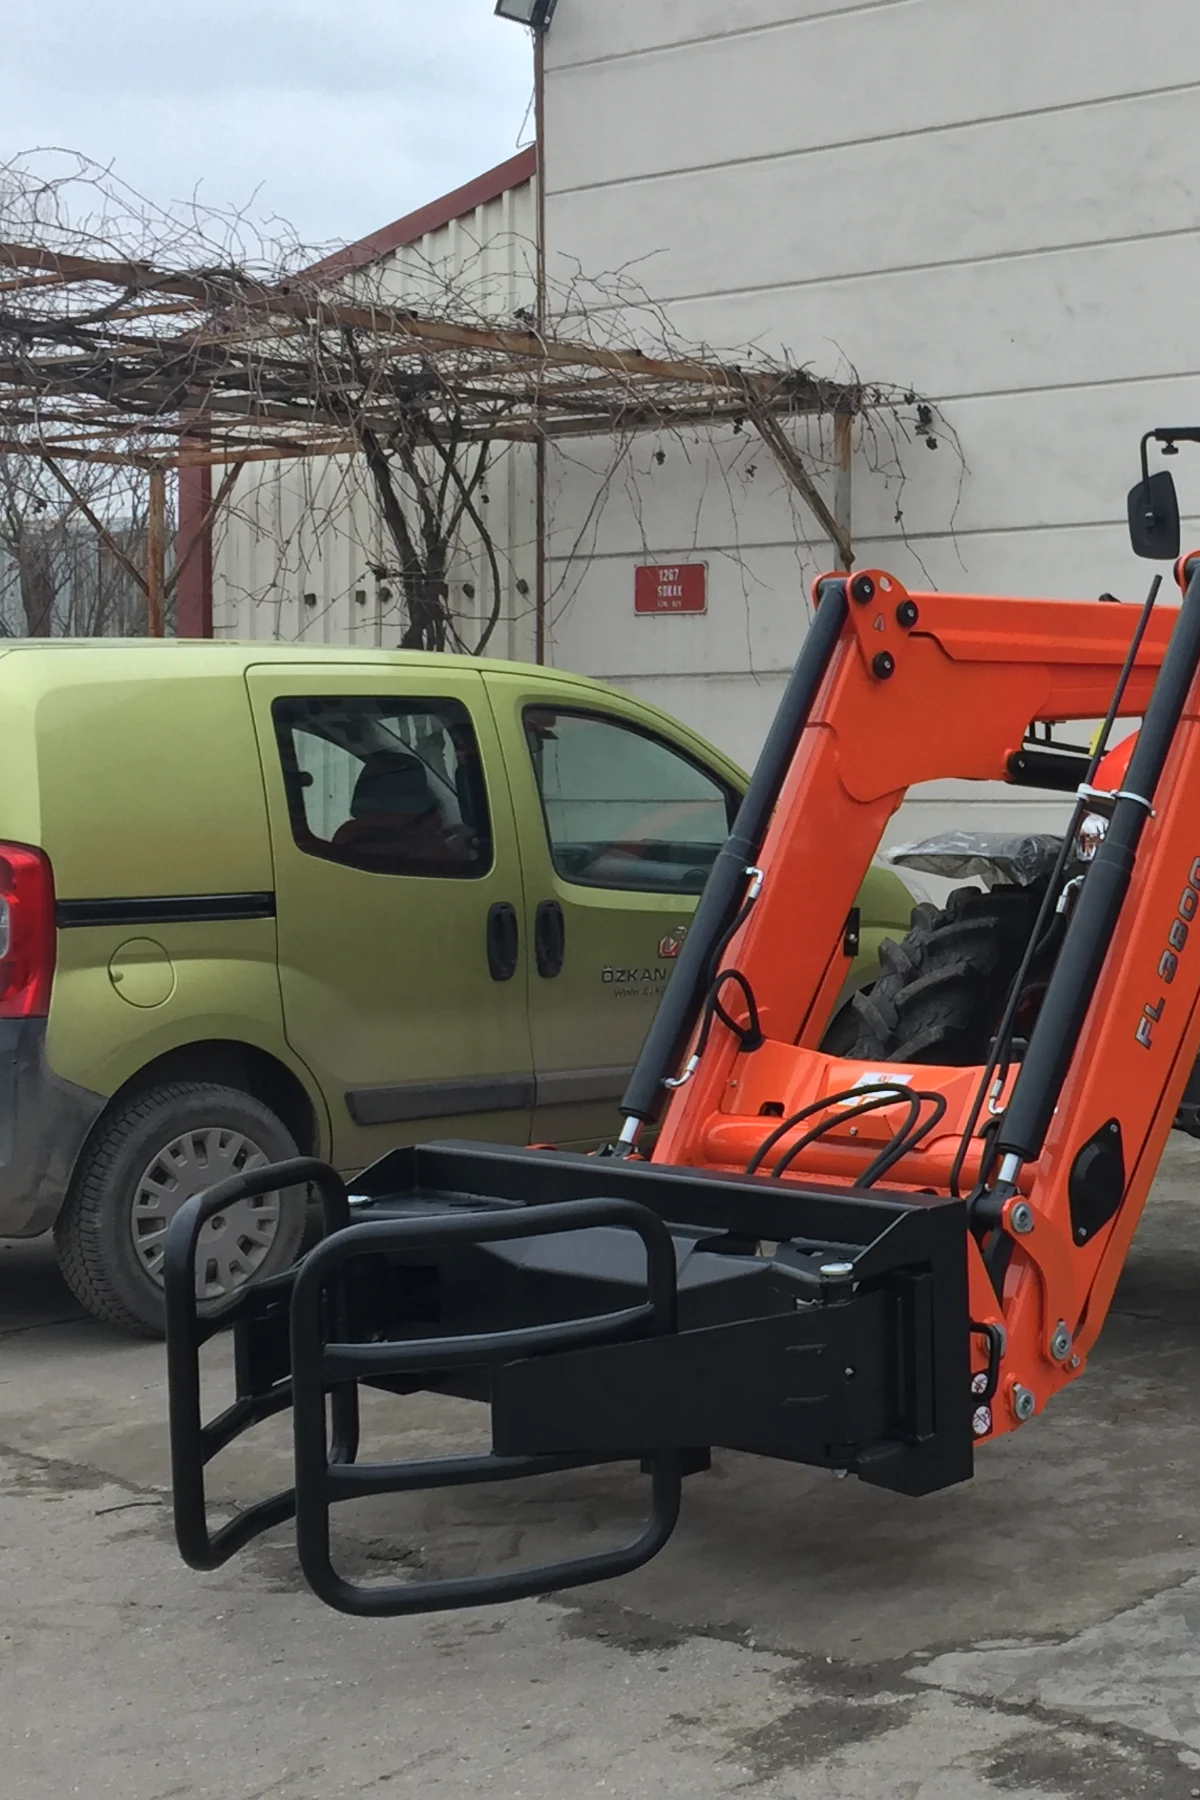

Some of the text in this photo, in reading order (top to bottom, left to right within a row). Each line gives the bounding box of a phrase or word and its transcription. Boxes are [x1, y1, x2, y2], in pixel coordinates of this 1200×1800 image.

[659, 568, 679, 582] 1267
[601, 966, 667, 983] ÖZKAN
[1135, 996, 1166, 1050] FL
